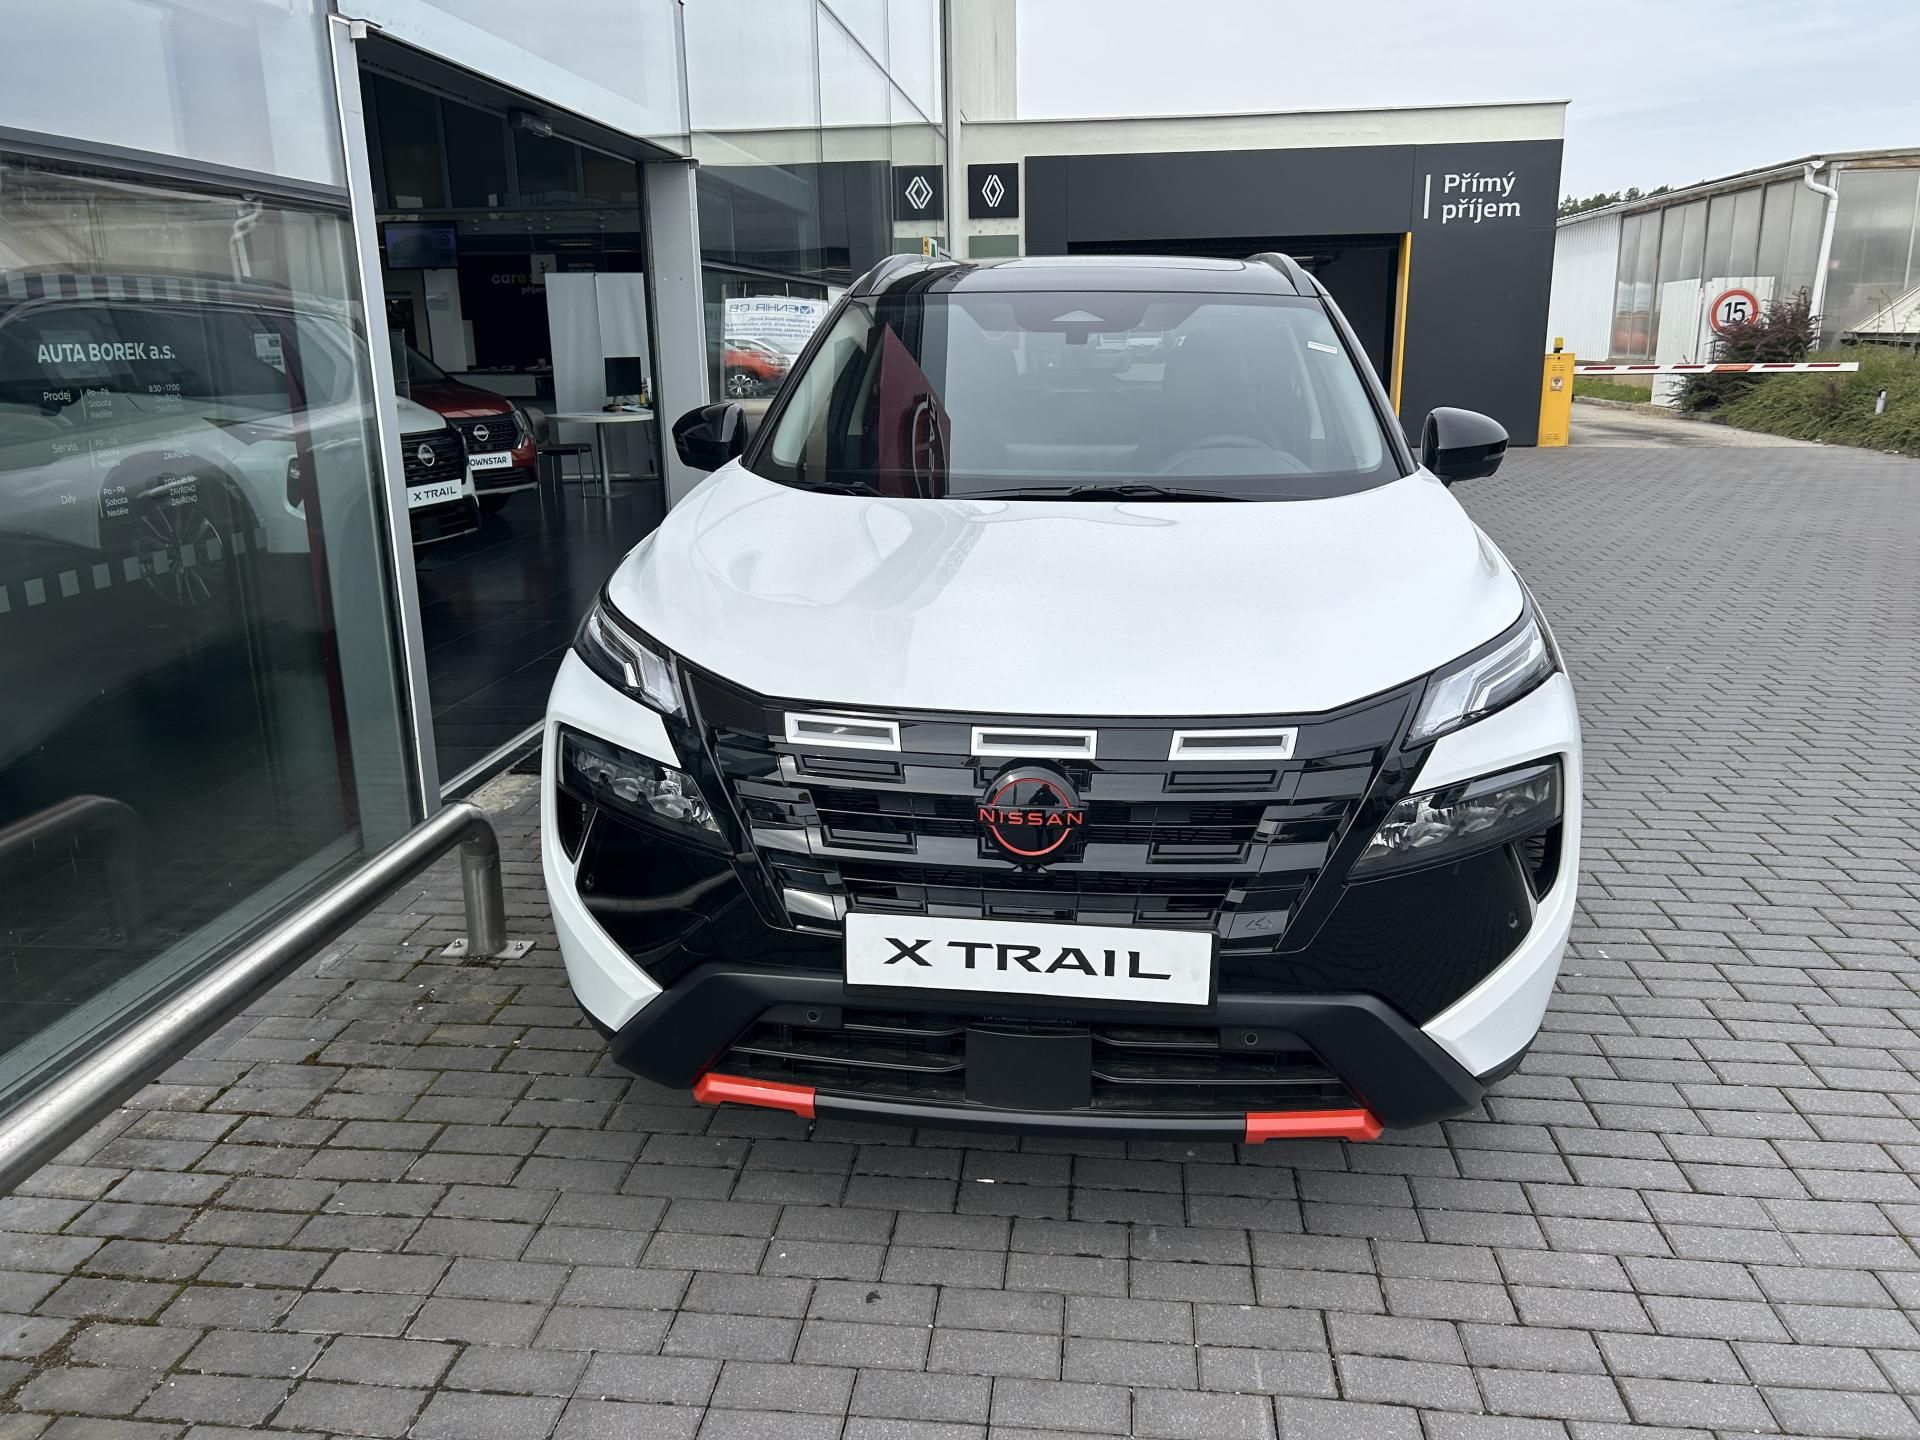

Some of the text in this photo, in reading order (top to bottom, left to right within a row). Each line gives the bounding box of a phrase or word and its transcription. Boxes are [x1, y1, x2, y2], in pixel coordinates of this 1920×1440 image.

[1443, 170, 1516, 197] Přímý
[1441, 199, 1521, 224] příjem
[491, 273, 526, 284] care
[1723, 300, 1746, 322] 15
[37, 342, 176, 364] AUTA BOREK a.s.
[43, 389, 71, 402] Prodej
[88, 399, 112, 408] Sobota
[52, 442, 79, 454] Servis
[470, 456, 507, 466] OWNSTAR
[105, 497, 128, 507] Sobota
[413, 486, 457, 502] X TRAIL
[978, 807, 1083, 826] NISSAN
[883, 938, 1172, 980] X TRAIL
